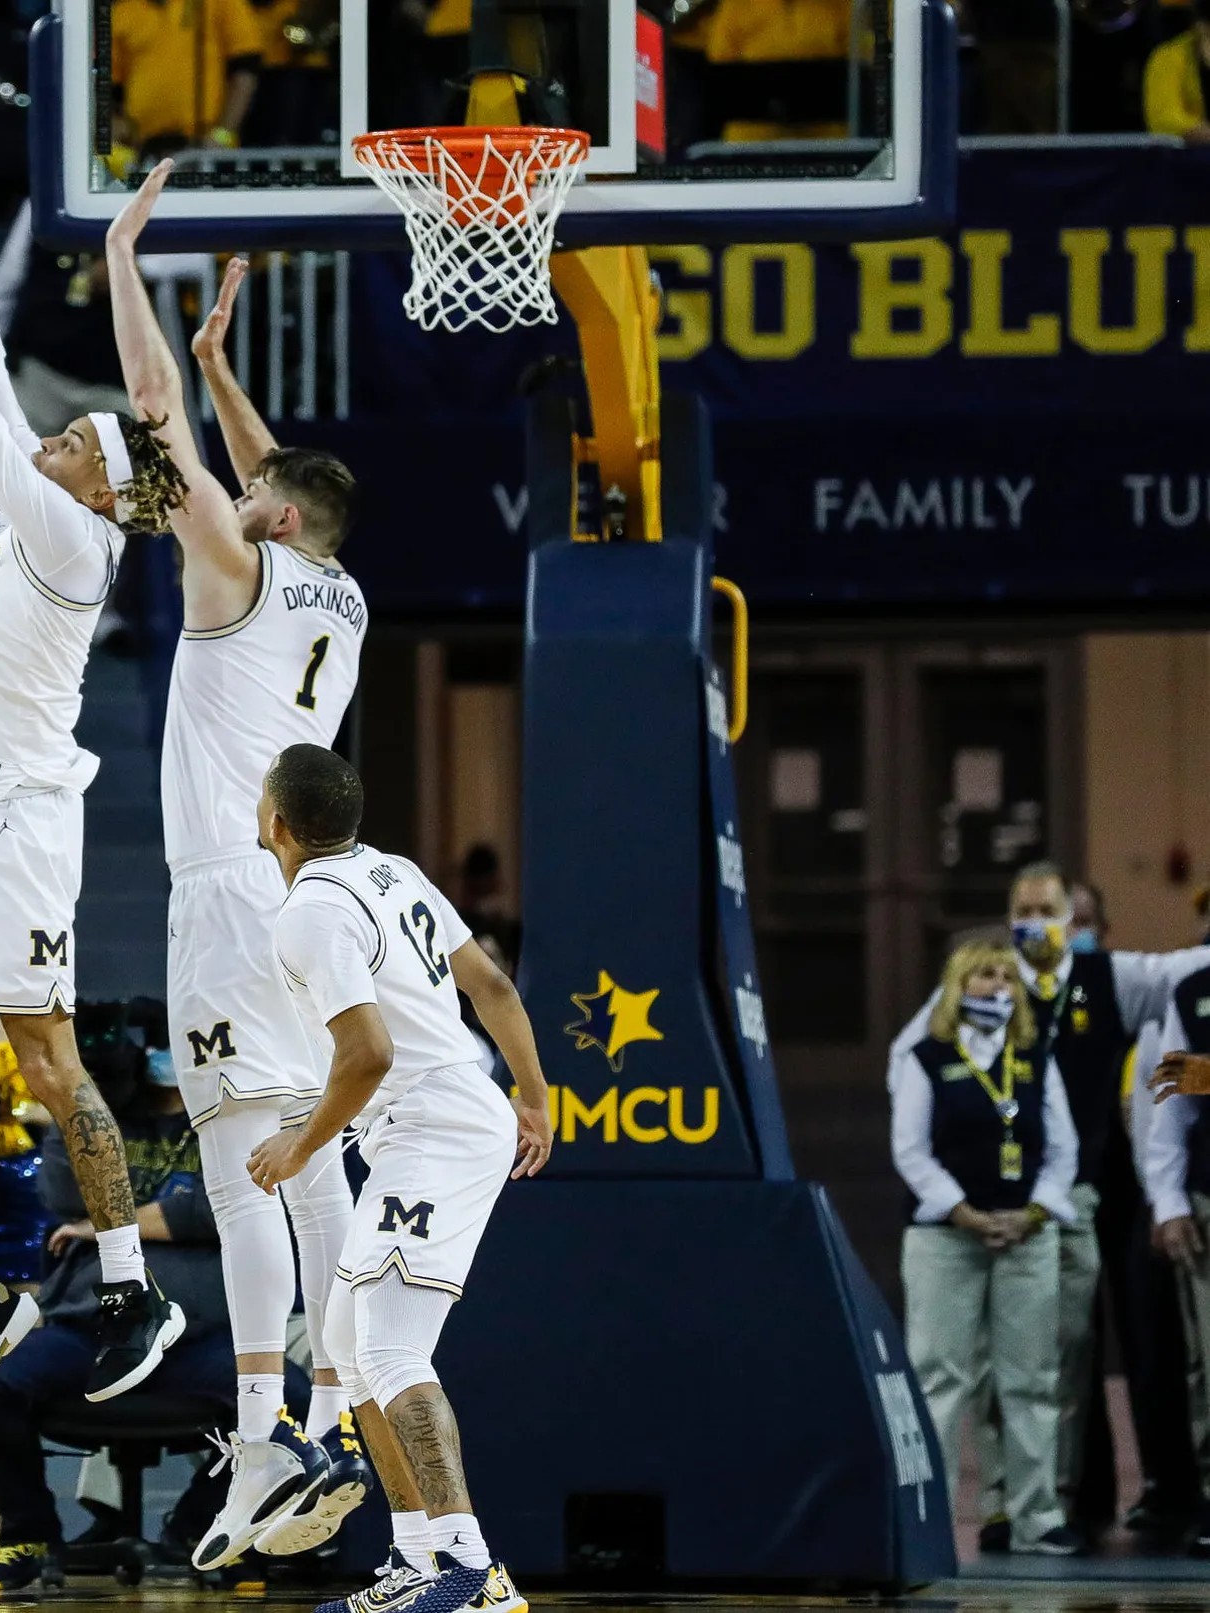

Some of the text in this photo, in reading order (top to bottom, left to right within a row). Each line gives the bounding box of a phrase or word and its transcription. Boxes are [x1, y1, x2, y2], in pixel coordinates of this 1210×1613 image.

[850, 226, 1210, 359] BLU
[815, 474, 1210, 532] FAMILY TU
[282, 583, 367, 636] DICKINSON
[295, 632, 332, 711] 1
[29, 928, 69, 967] M
[398, 899, 450, 989] 12
[187, 1020, 237, 1067] M
[378, 1195, 435, 1240] M
